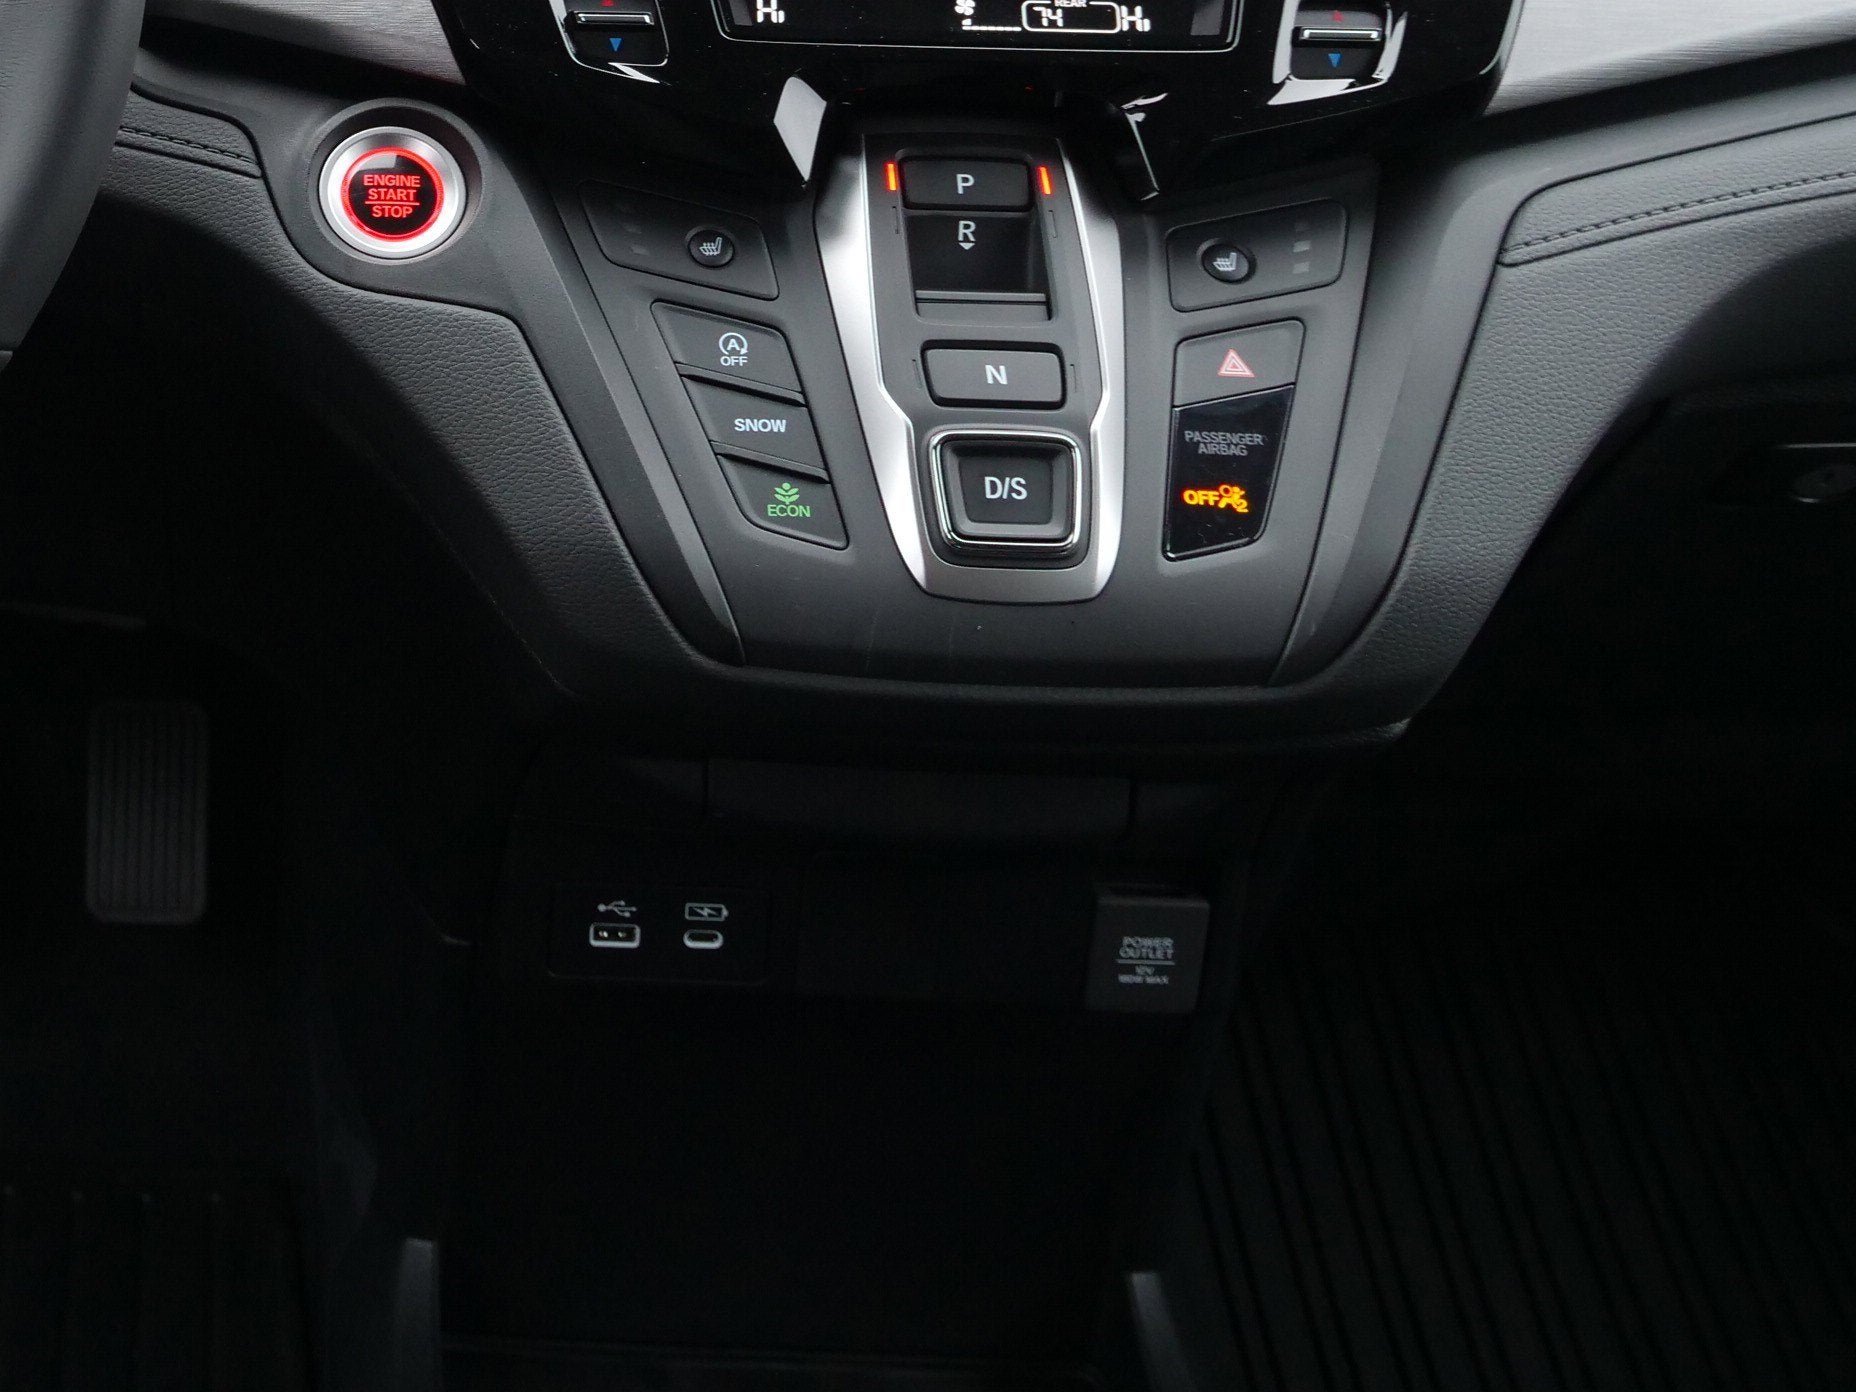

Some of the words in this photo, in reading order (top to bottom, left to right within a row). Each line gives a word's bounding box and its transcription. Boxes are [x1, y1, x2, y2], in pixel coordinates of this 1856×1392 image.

[1033, 6, 1064, 27] 74
[363, 174, 421, 188] ENGINE
[956, 174, 975, 194] P
[368, 188, 417, 201] START
[372, 205, 413, 218] STOP
[958, 221, 976, 242] R
[720, 356, 748, 366] OFF
[985, 365, 1008, 385] N
[734, 418, 787, 432] SNOW
[1184, 431, 1264, 446] PASSENGER
[1197, 444, 1248, 456] AIRBAG
[984, 477, 1028, 500] D/S
[1183, 490, 1220, 505] OFF
[767, 504, 811, 517] ECON
[1119, 947, 1174, 959] OUTLET
